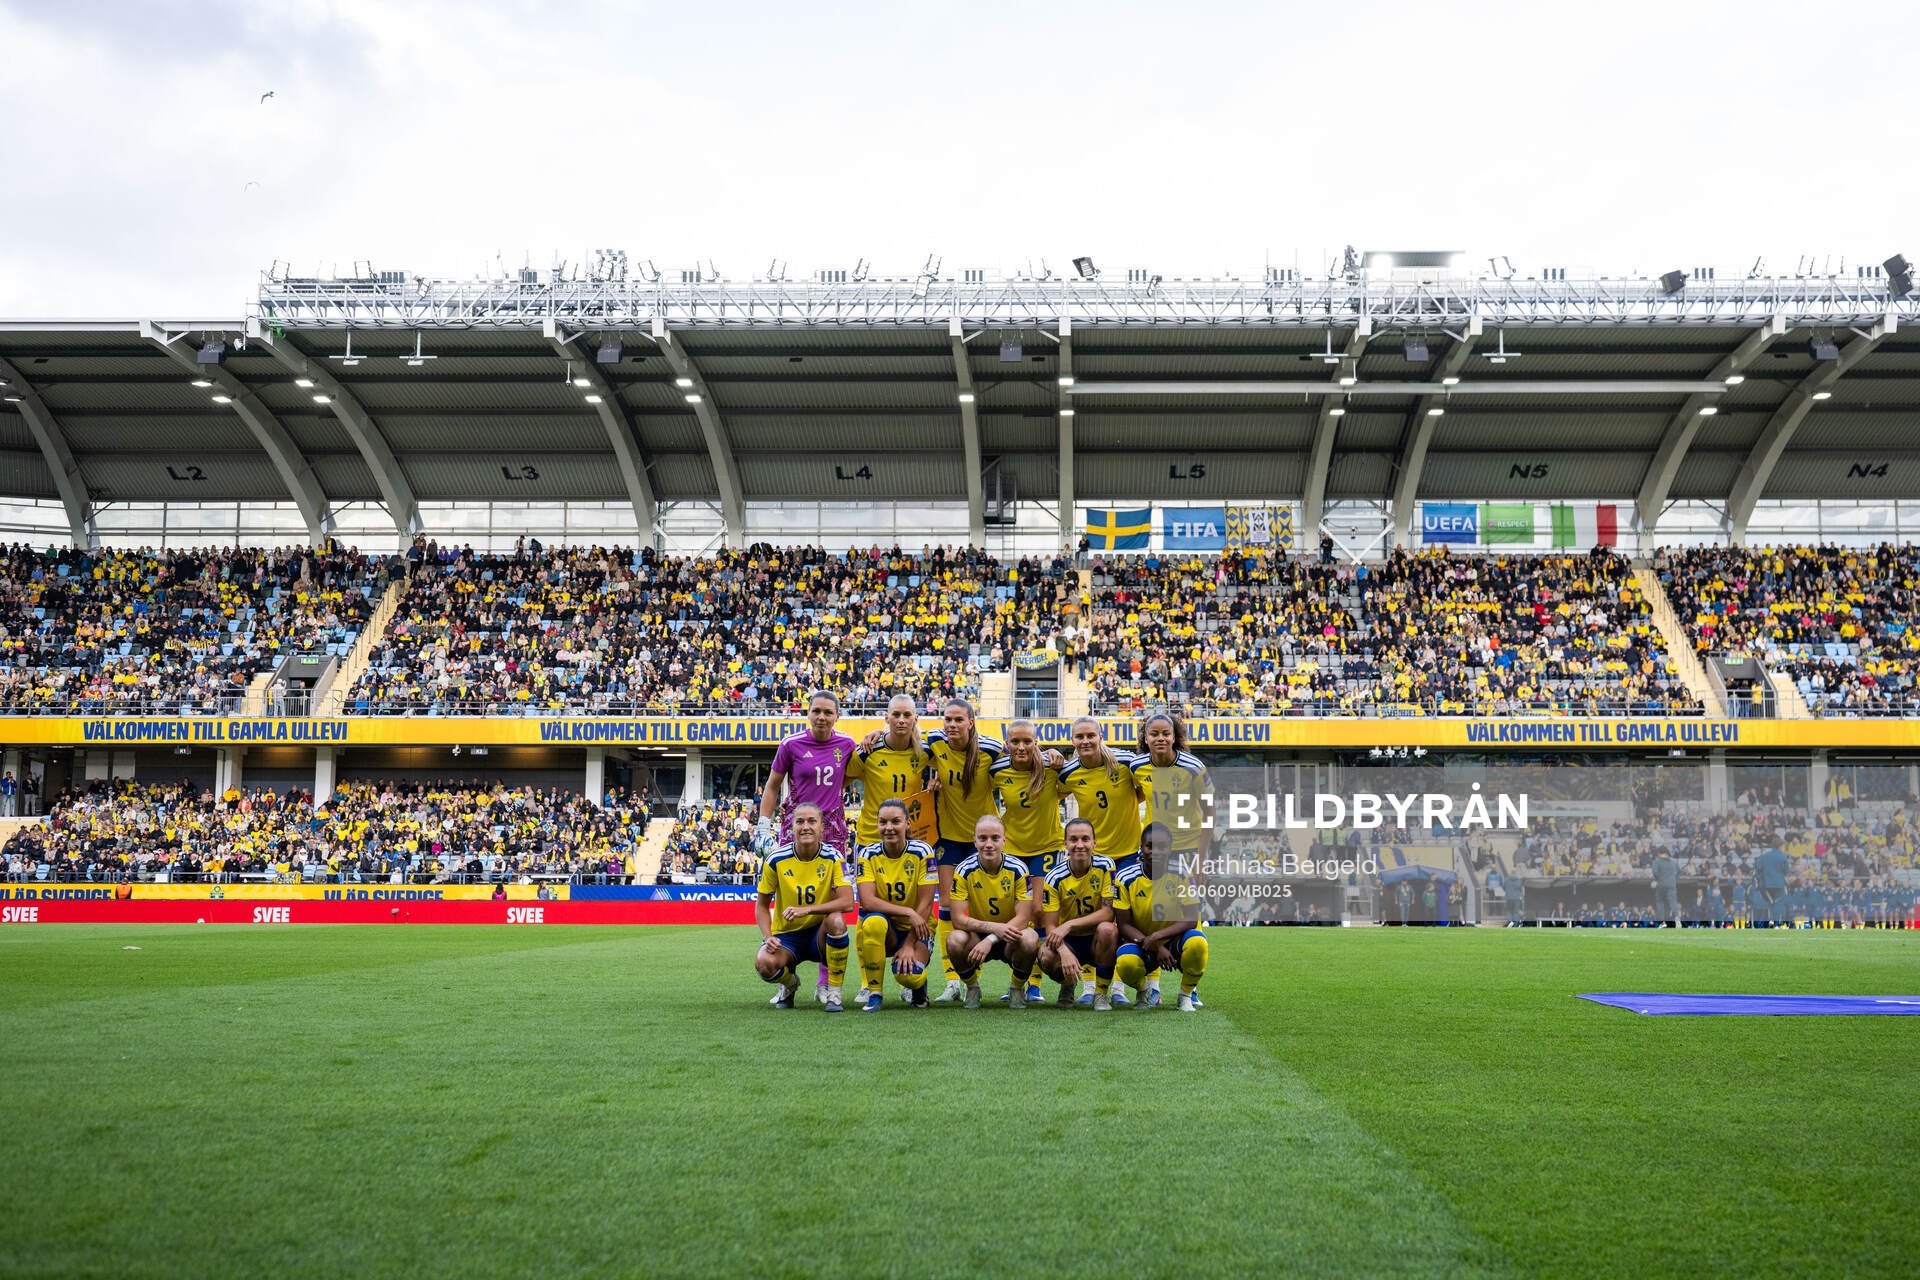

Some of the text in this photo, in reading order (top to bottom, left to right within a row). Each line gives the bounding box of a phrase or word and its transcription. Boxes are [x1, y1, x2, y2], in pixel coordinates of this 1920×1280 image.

[167, 467, 206, 481] L2
[502, 466, 539, 481] L3
[836, 465, 873, 480] L4
[1169, 464, 1206, 479] L5
[1509, 464, 1549, 479] N5
[1848, 463, 1889, 479] N4
[1172, 522, 1218, 538] FIFA
[1425, 515, 1474, 531] UEFA
[1497, 520, 1529, 528] RESPECT
[84, 721, 348, 741] VÄLKOMMEN TILL GAMLA ULLEVI
[541, 722, 646, 741] VÄLKOMMEN
[651, 722, 682, 741] TILL
[687, 722, 746, 741] GAMLA
[1113, 723, 1141, 741] TIL
[1213, 723, 1270, 742] ULLEVI
[1467, 723, 1739, 742] VÄLKOMMEN TILL GAMLA ULLEVI
[815, 765, 834, 787] 12
[892, 773, 906, 793] 11
[1019, 791, 1031, 809] 2
[1095, 790, 1108, 809] 3
[1152, 790, 1171, 810] 17
[1043, 855, 1053, 872] 2
[796, 885, 816, 906] 16
[886, 881, 906, 902] 19
[2, 906, 38, 923] SVEE
[253, 906, 290, 923] SVEE
[988, 897, 1001, 916] 5
[1075, 895, 1095, 916] 15
[1153, 903, 1166, 921] 6
[506, 907, 544, 924] SVEE
